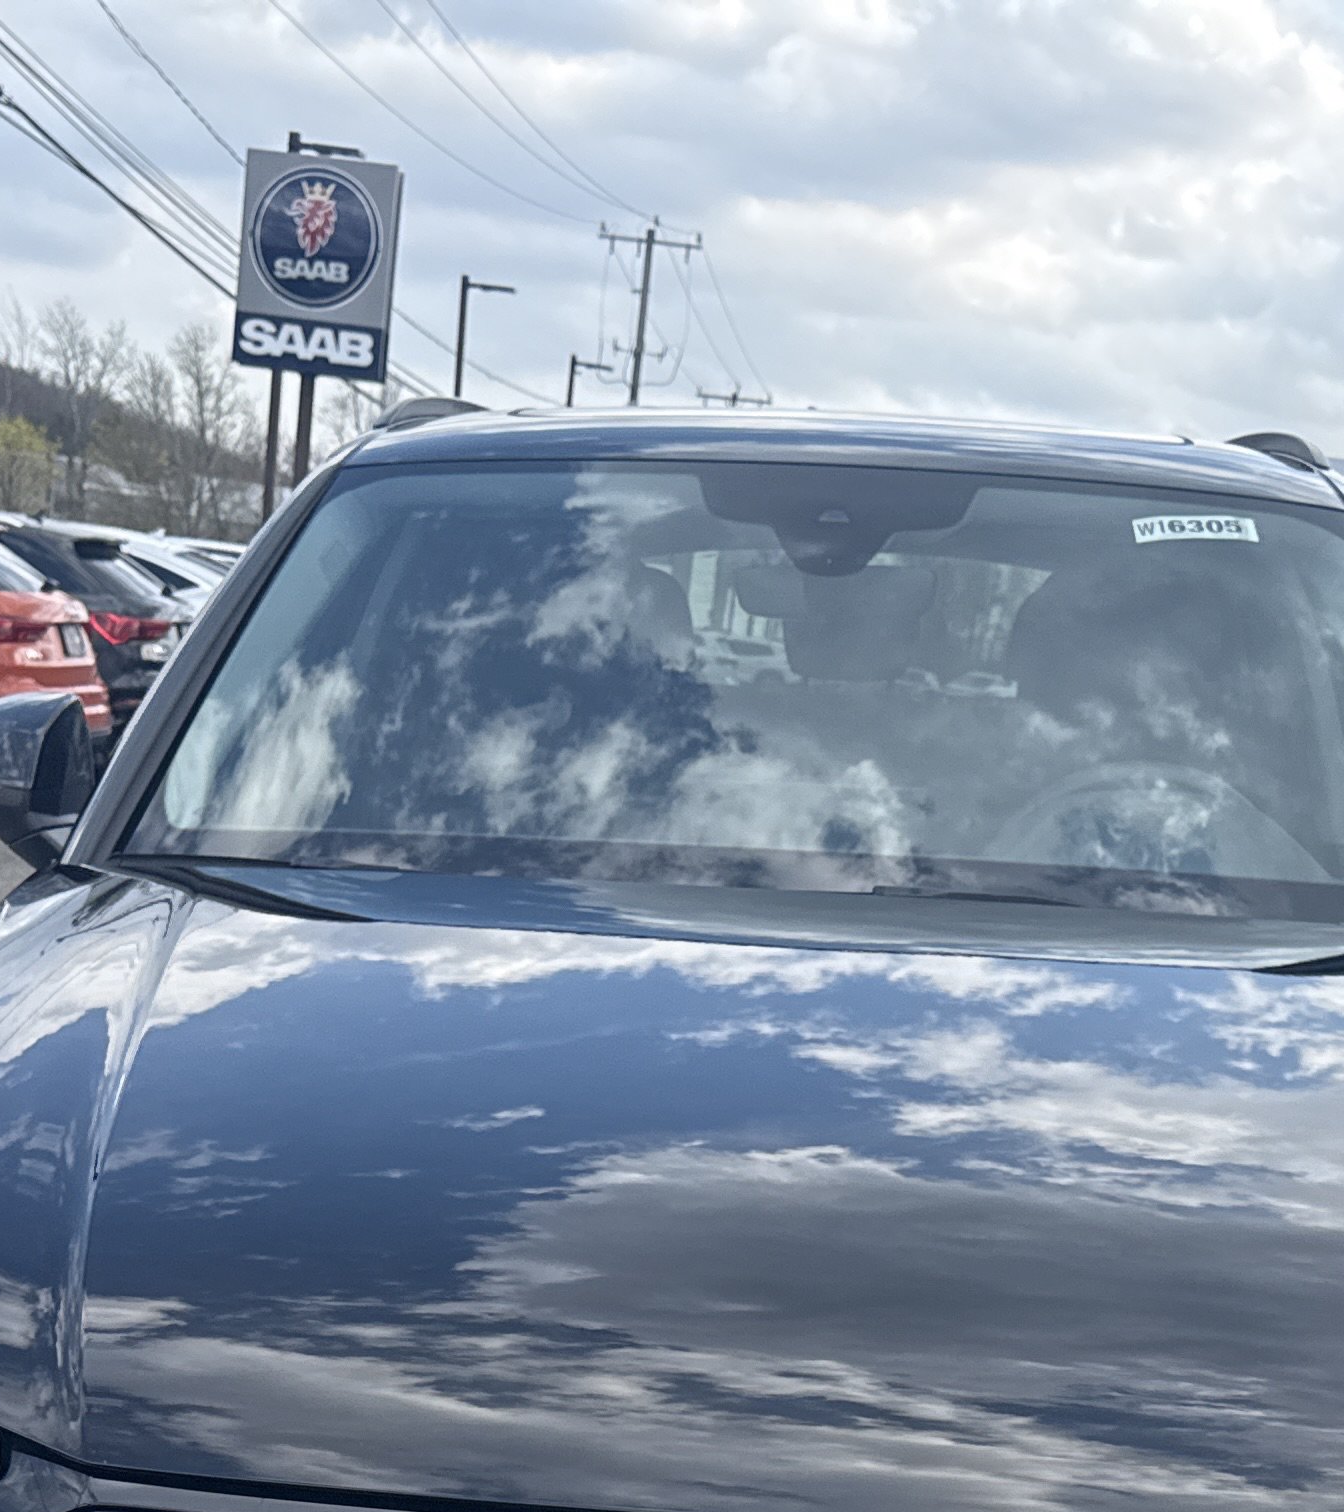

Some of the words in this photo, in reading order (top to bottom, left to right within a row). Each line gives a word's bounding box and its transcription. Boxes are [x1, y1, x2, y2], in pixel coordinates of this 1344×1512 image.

[273, 257, 350, 284] SAAB
[238, 317, 375, 368] SAAB
[1137, 519, 1243, 537] W16305
